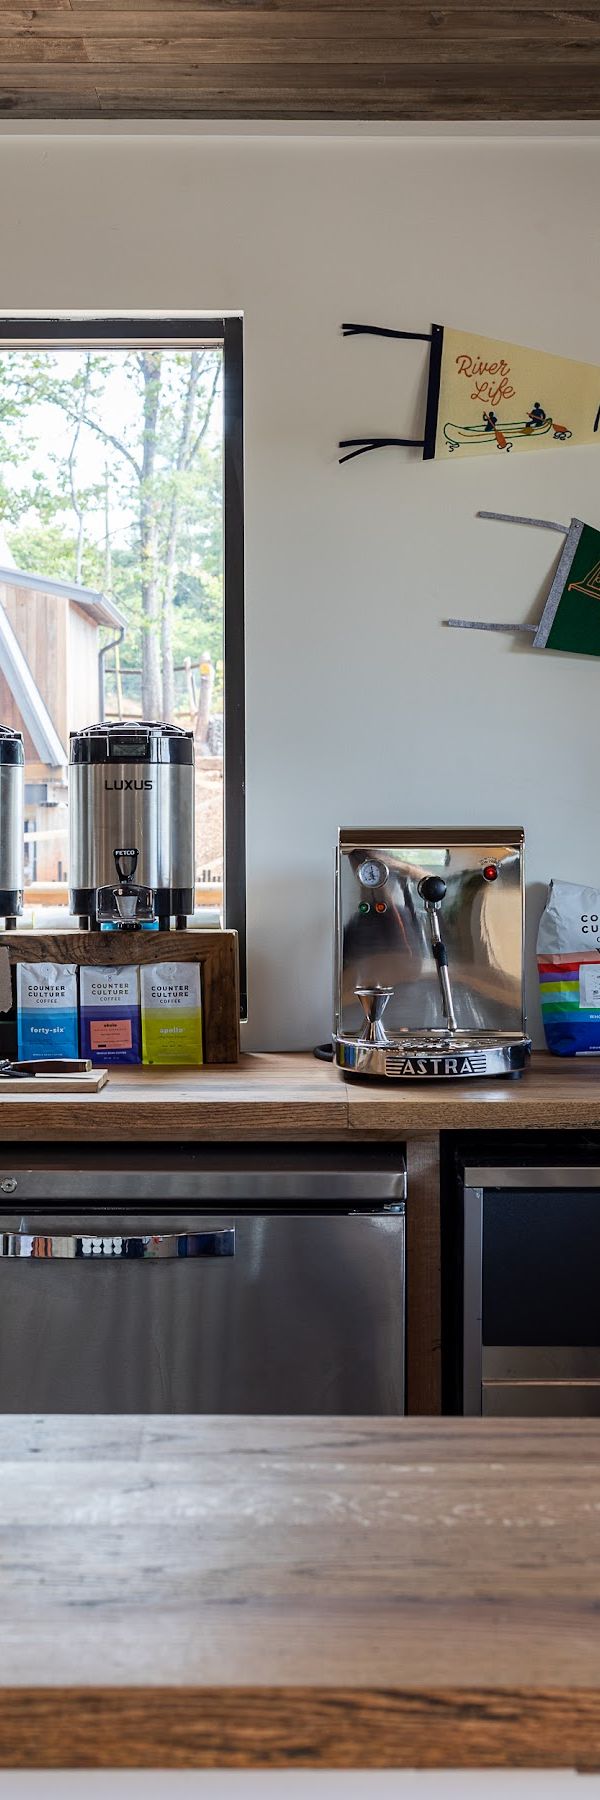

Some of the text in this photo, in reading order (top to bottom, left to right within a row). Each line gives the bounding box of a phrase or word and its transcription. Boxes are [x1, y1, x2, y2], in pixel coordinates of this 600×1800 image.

[455, 354, 511, 378] River
[470, 377, 516, 406] Life
[104, 780, 153, 791] LUXUS
[30, 1026, 65, 1035] forty-six
[402, 1058, 472, 1075] ASTRA
